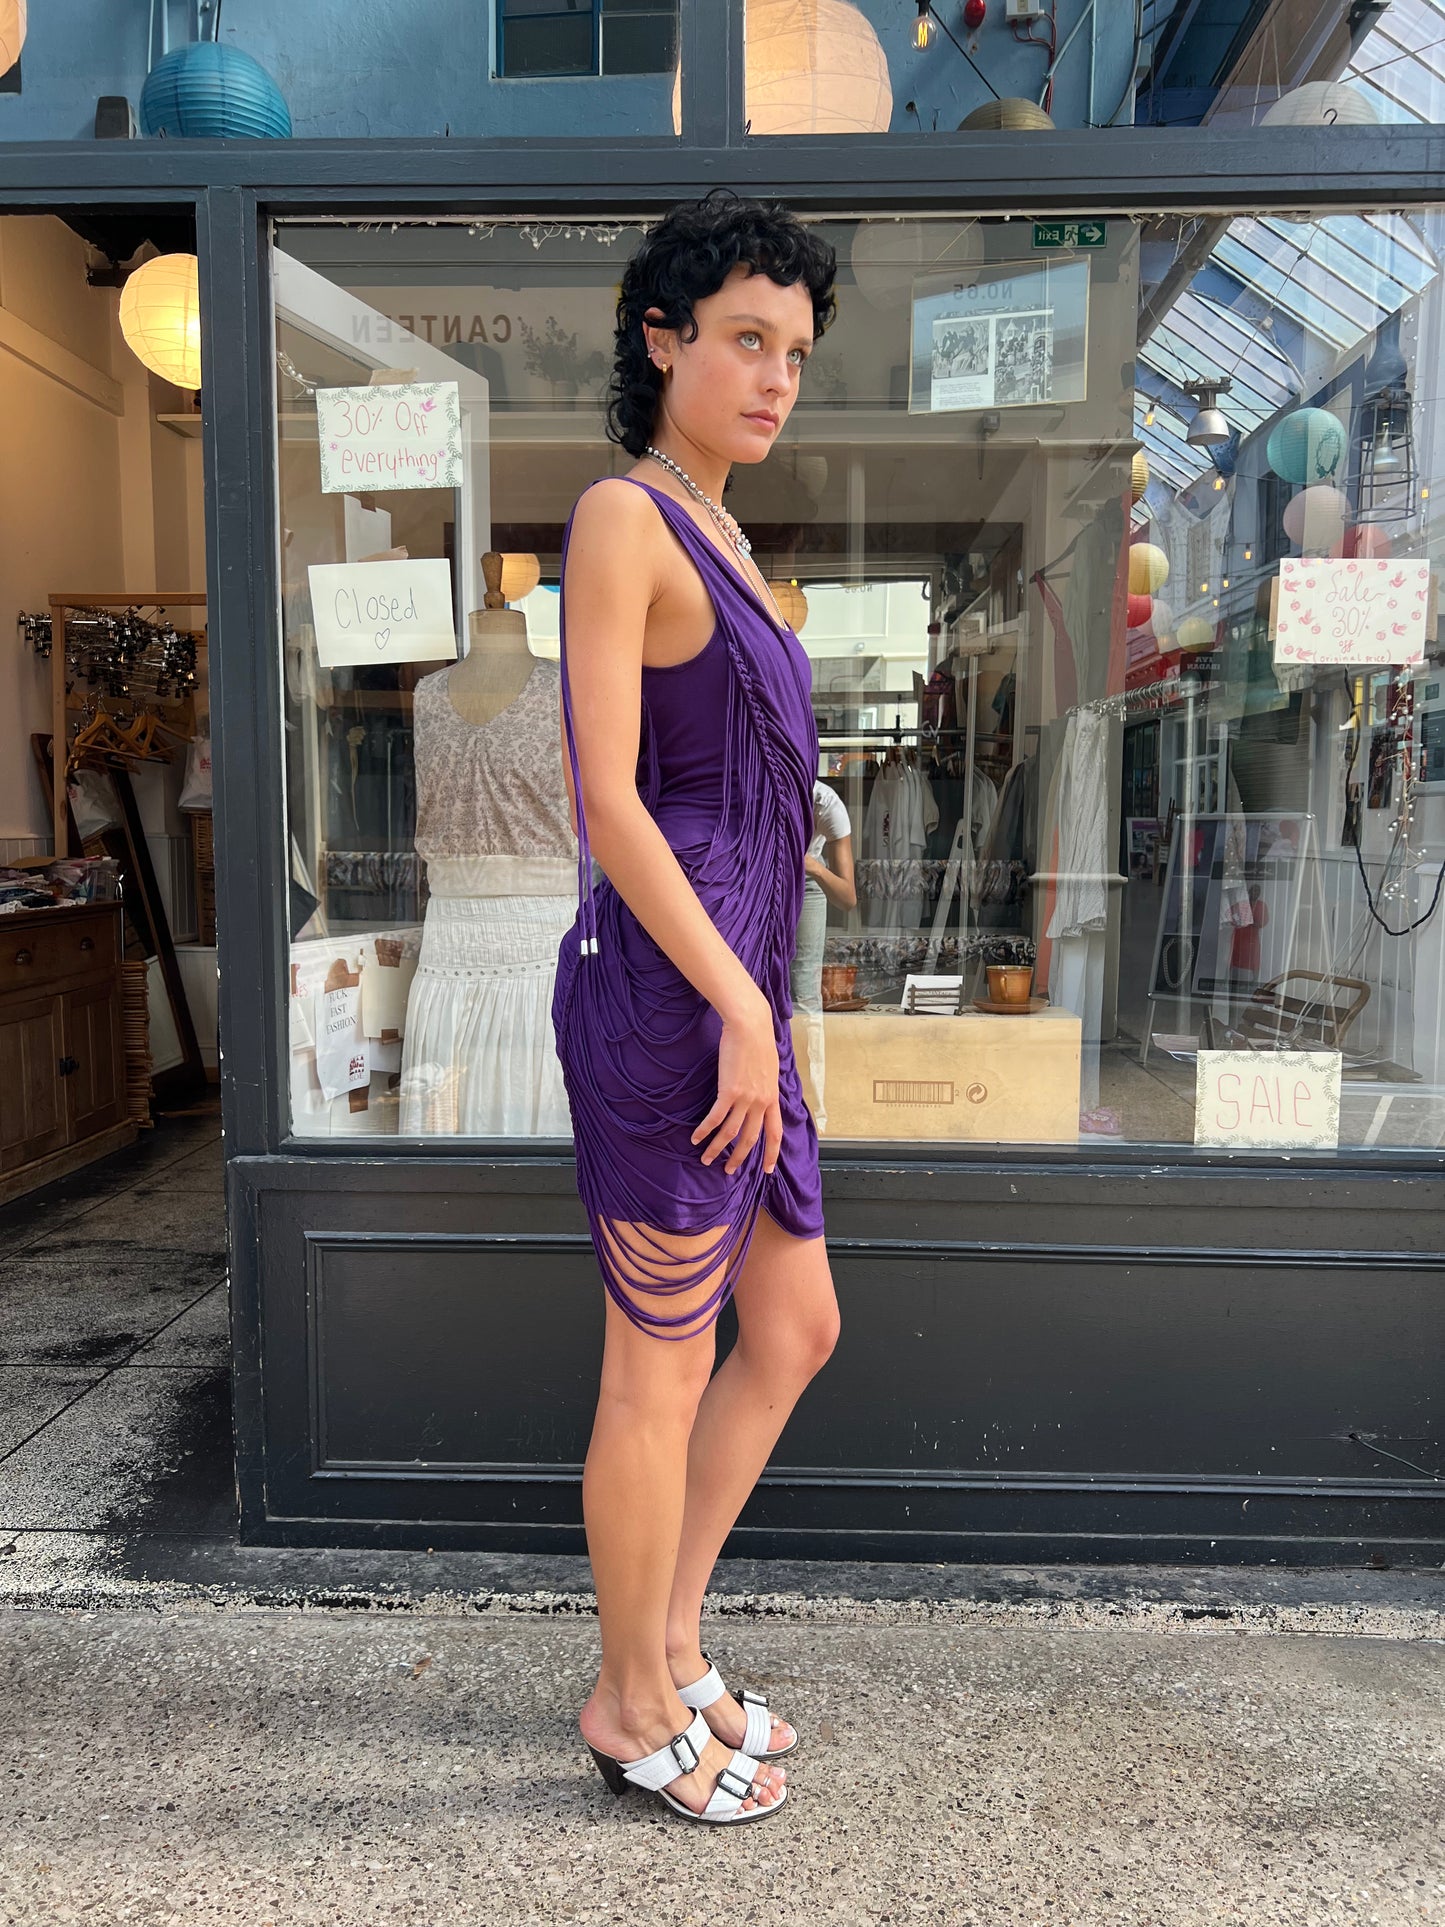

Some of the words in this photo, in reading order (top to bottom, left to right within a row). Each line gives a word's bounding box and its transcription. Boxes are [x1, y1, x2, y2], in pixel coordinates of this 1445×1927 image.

[333, 400, 383, 438] 30%
[341, 447, 438, 481] everything
[1325, 569, 1386, 603] Sale
[334, 587, 419, 629] Closed
[1332, 606, 1372, 638] 30%
[1338, 639, 1355, 654] off
[326, 1015, 357, 1035] FASHION
[330, 1003, 347, 1018] FAST
